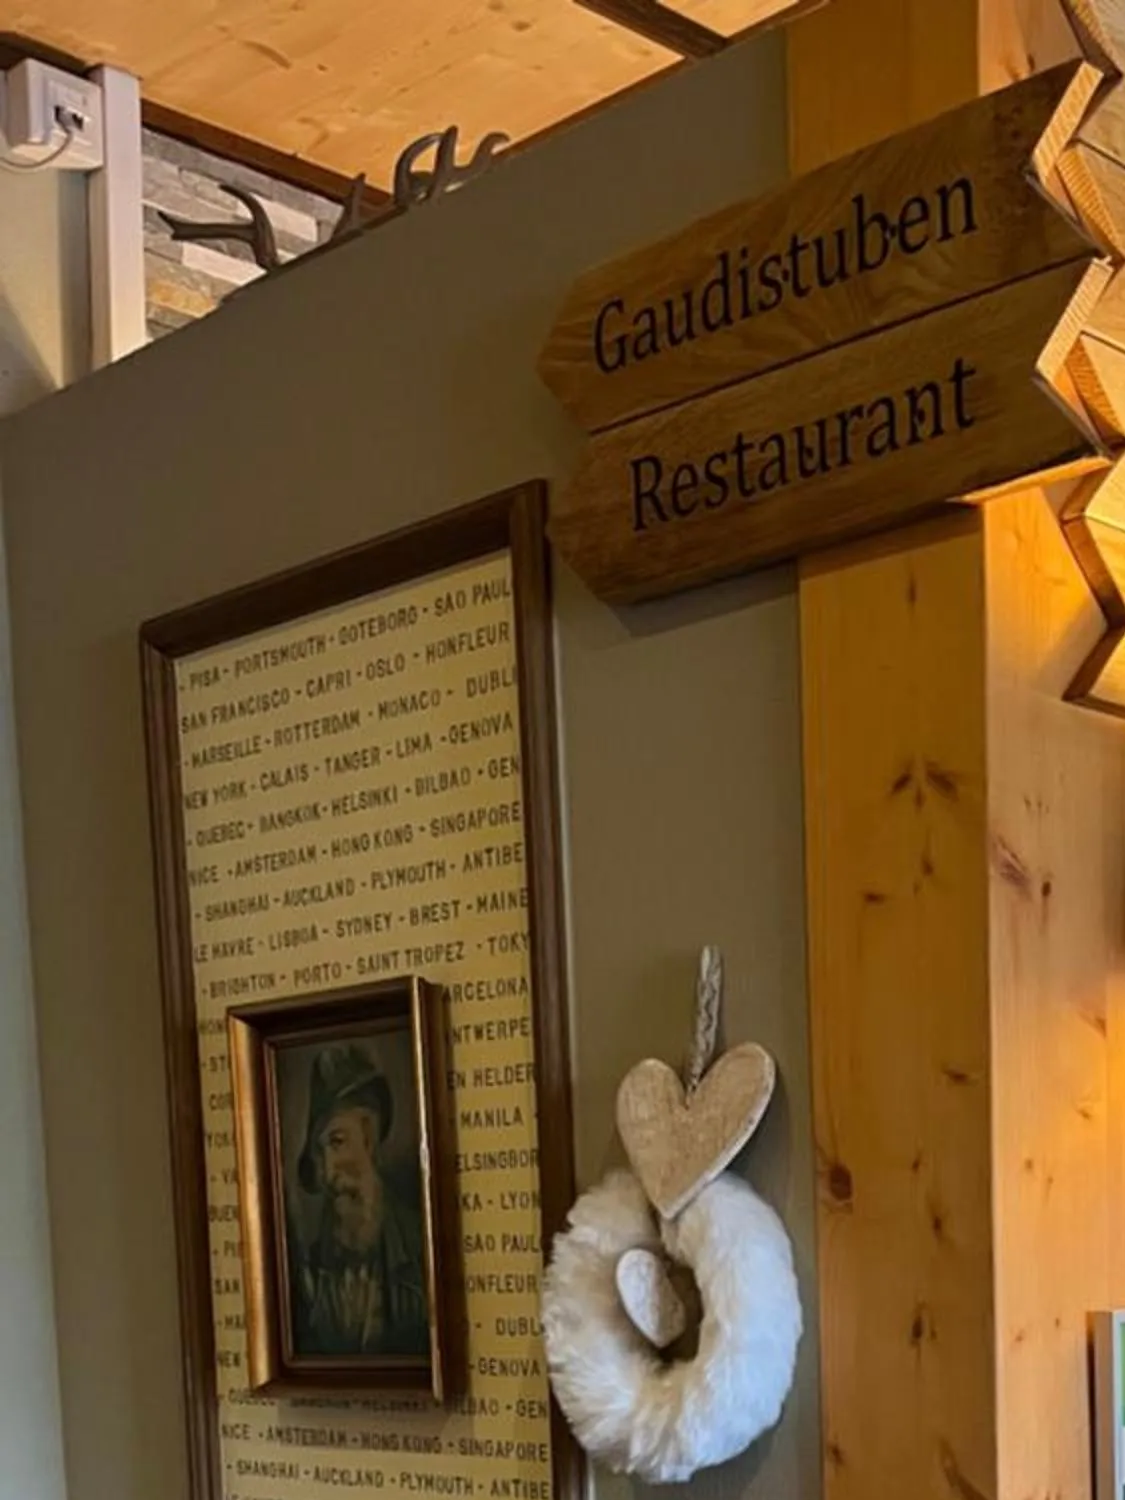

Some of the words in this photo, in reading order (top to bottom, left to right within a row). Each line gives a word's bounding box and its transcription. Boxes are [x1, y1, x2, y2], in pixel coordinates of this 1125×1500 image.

[593, 175, 978, 376] Gaudistuben
[630, 357, 977, 531] Restaurant
[181, 710, 207, 734] SAN
[211, 685, 290, 726] FRANCISCO
[305, 667, 351, 699] CAPRI
[365, 651, 405, 682] OSLO
[425, 619, 509, 663] HONFLEUR
[189, 665, 220, 691] PISA
[234, 632, 325, 678] PORTSMOUTH
[191, 734, 261, 770] MARSEILLE
[274, 707, 360, 749] ROTTERDAM
[377, 686, 440, 722] MONACO
[212, 779, 246, 805] YORK
[260, 762, 308, 792] CALAIS
[324, 745, 381, 777] TANGER
[395, 731, 432, 759] LIMA
[448, 710, 513, 746] GENOVA
[195, 819, 244, 848] QUEBEC
[258, 802, 320, 834] BANGKOK
[331, 783, 398, 817] HELSINKI
[414, 765, 471, 797] BILBAO
[234, 844, 317, 878] AMSTERDAM
[373, 823, 414, 850] KONG
[429, 800, 521, 838] SINGAPORE
[204, 893, 269, 922] SHANGHAI
[283, 877, 355, 909] AUCKLAND
[370, 858, 446, 891] PLYMOUTH
[461, 841, 522, 872] ANTIBE
[211, 936, 254, 960] HAVRE
[268, 924, 318, 951] LISBOA
[335, 910, 392, 938] SYDNEY
[409, 899, 460, 926] BREST
[476, 887, 527, 915] MAINE
[209, 971, 276, 998] BRIGHTON
[293, 961, 342, 986] PORTO
[355, 950, 400, 975] SAINT
[404, 940, 465, 968] TROPEZ
[460, 1106, 523, 1130] MANILA
[477, 1357, 541, 1378] GENOVA
[266, 1426, 347, 1448] AMSTERDAM
[402, 1434, 443, 1454] KONG
[457, 1438, 548, 1462] SINGAPORE
[313, 1466, 384, 1488] AUCKLAND
[399, 1472, 473, 1495] PLYMOUTH
[489, 1477, 549, 1500] ANTIBE
